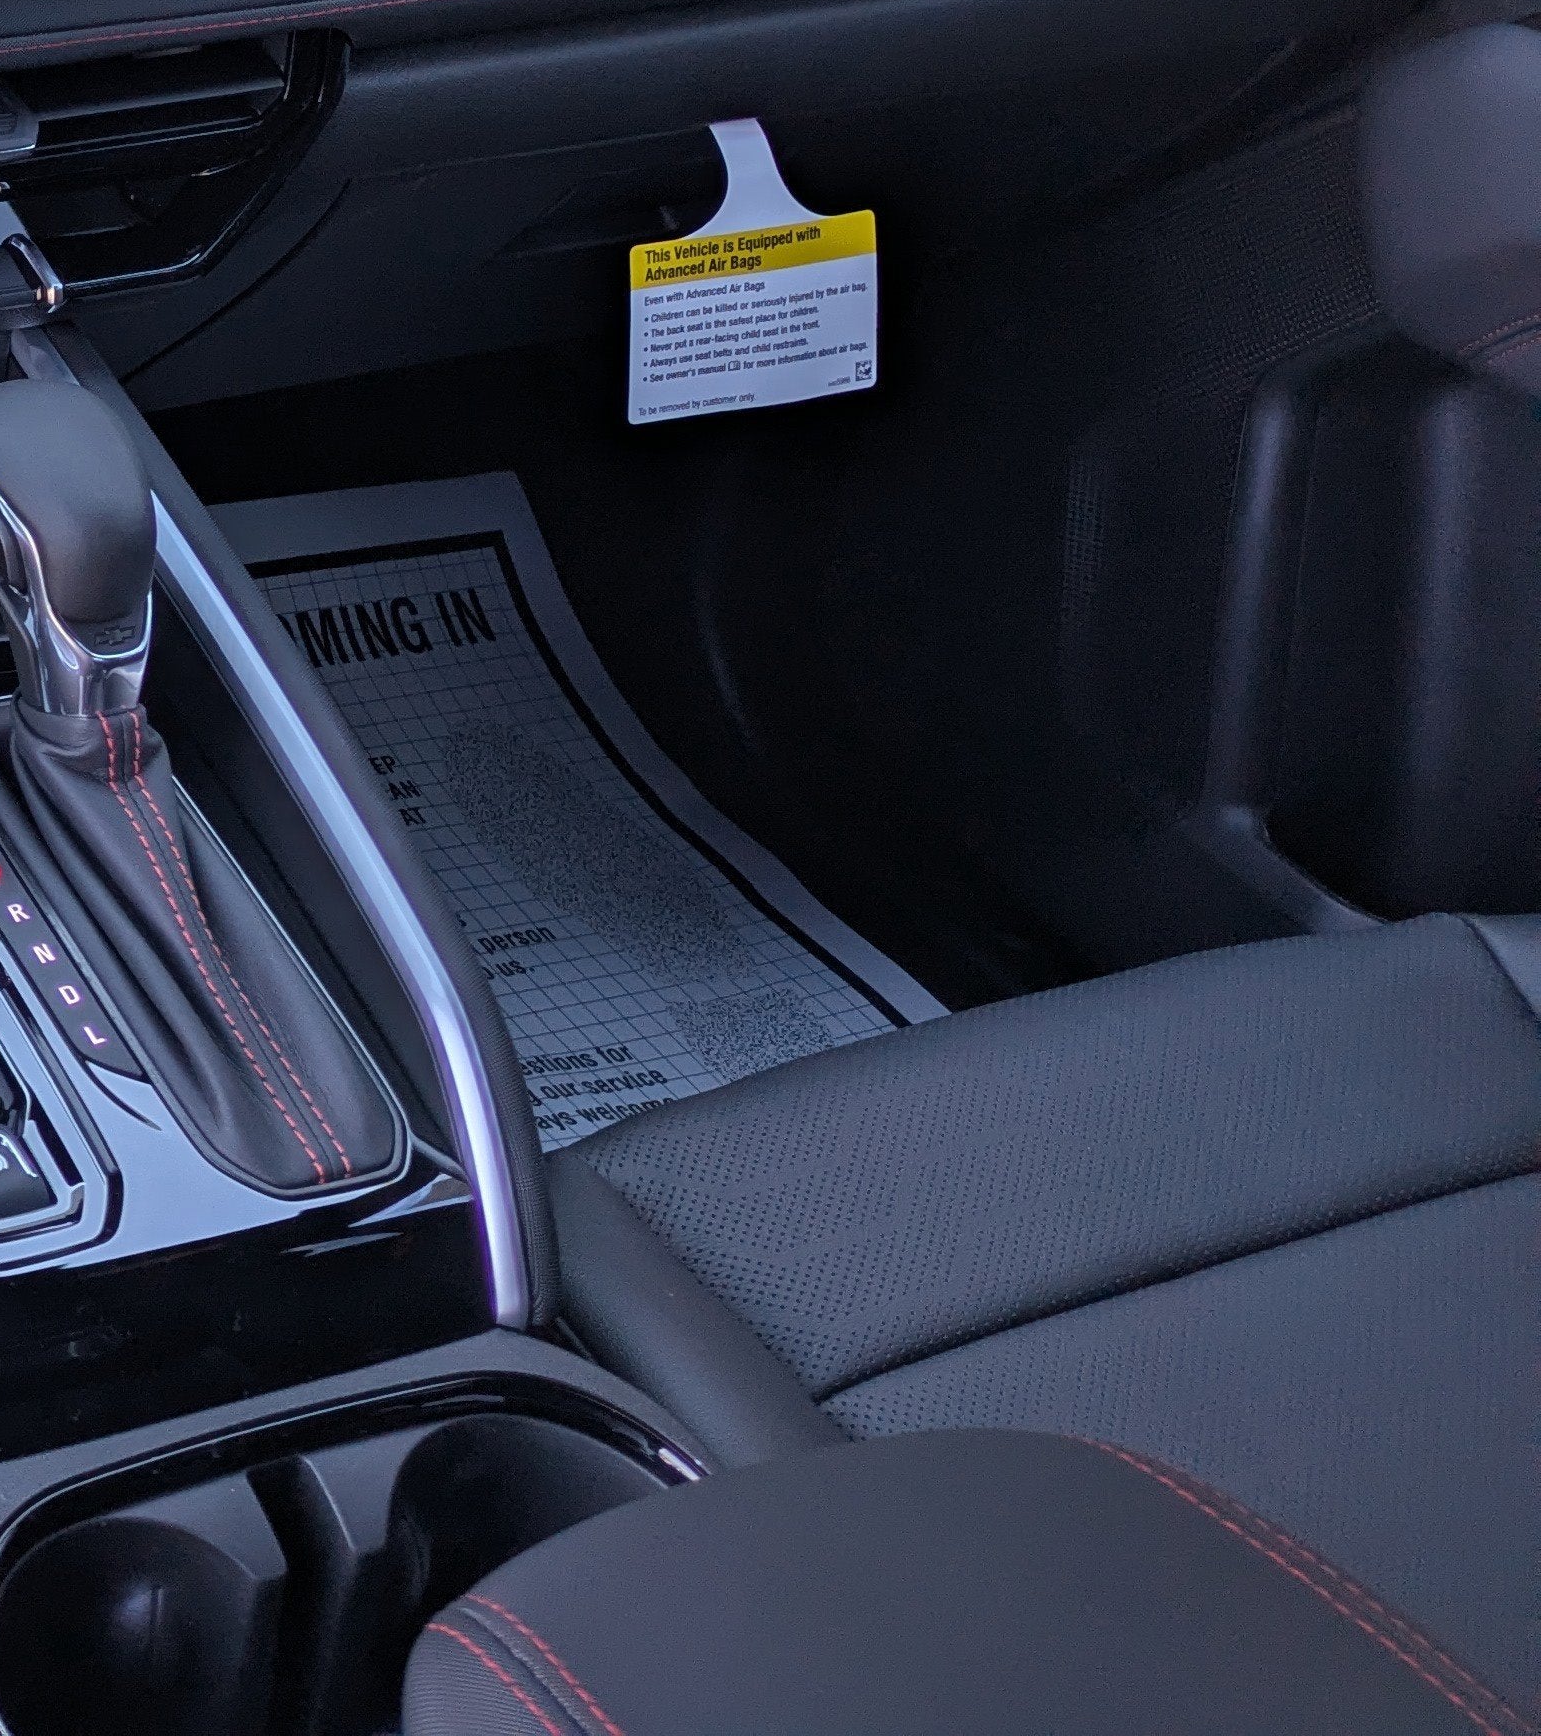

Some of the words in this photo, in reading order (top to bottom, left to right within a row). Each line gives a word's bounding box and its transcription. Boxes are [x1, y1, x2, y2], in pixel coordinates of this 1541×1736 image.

[645, 249, 671, 264] This
[674, 243, 720, 260] Vehicle
[723, 240, 734, 253] is
[738, 230, 793, 253] Equipped
[796, 226, 821, 242] with
[645, 261, 705, 282] Advanced
[709, 256, 727, 273] Air
[731, 254, 762, 271] Bags
[644, 295, 664, 306] Even
[666, 291, 684, 303] with
[686, 285, 727, 299] Advanced
[729, 282, 742, 294] Air
[744, 280, 766, 292] Bags
[651, 310, 684, 323] Children
[686, 308, 700, 318] can
[703, 306, 713, 315] be
[715, 302, 738, 313] killed
[751, 296, 787, 309] seriously
[816, 289, 825, 300] by
[826, 286, 838, 296] the
[840, 284, 850, 294] air
[651, 328, 665, 338] The
[667, 325, 685, 336] back
[687, 322, 703, 332] seat
[714, 319, 727, 328] the
[729, 315, 754, 326] safest
[755, 313, 776, 324] place
[778, 310, 788, 320] for
[650, 343, 672, 353] Never
[674, 339, 687, 350] put
[696, 332, 739, 345] rear-facing
[741, 329, 761, 340] child
[762, 327, 779, 337] seat
[789, 324, 801, 333] the
[650, 356, 677, 368] Always
[679, 354, 693, 363] use
[695, 351, 711, 361] seat
[713, 347, 733, 358] belts
[735, 345, 750, 355] and
[752, 343, 771, 354] child
[650, 373, 664, 383] See
[666, 368, 696, 381] owner's
[698, 364, 726, 376] manual
[743, 360, 754, 370] for
[757, 358, 776, 368] more
[777, 351, 817, 365] information
[818, 346, 837, 357] about
[839, 344, 849, 354] air
[638, 407, 647, 416] To
[648, 406, 658, 415] be
[659, 401, 691, 413] removed
[691, 399, 701, 410] by
[702, 395, 737, 407] customer
[277, 596, 434, 668] MING
[435, 588, 496, 647] IN
[7, 903, 30, 924] R
[32, 942, 56, 964] N
[478, 926, 557, 956] person
[497, 960, 535, 978] us.
[58, 986, 80, 1005] D
[83, 1026, 106, 1046] L
[595, 1044, 635, 1064] for
[540, 1081, 581, 1100] our
[581, 1069, 668, 1095] service
